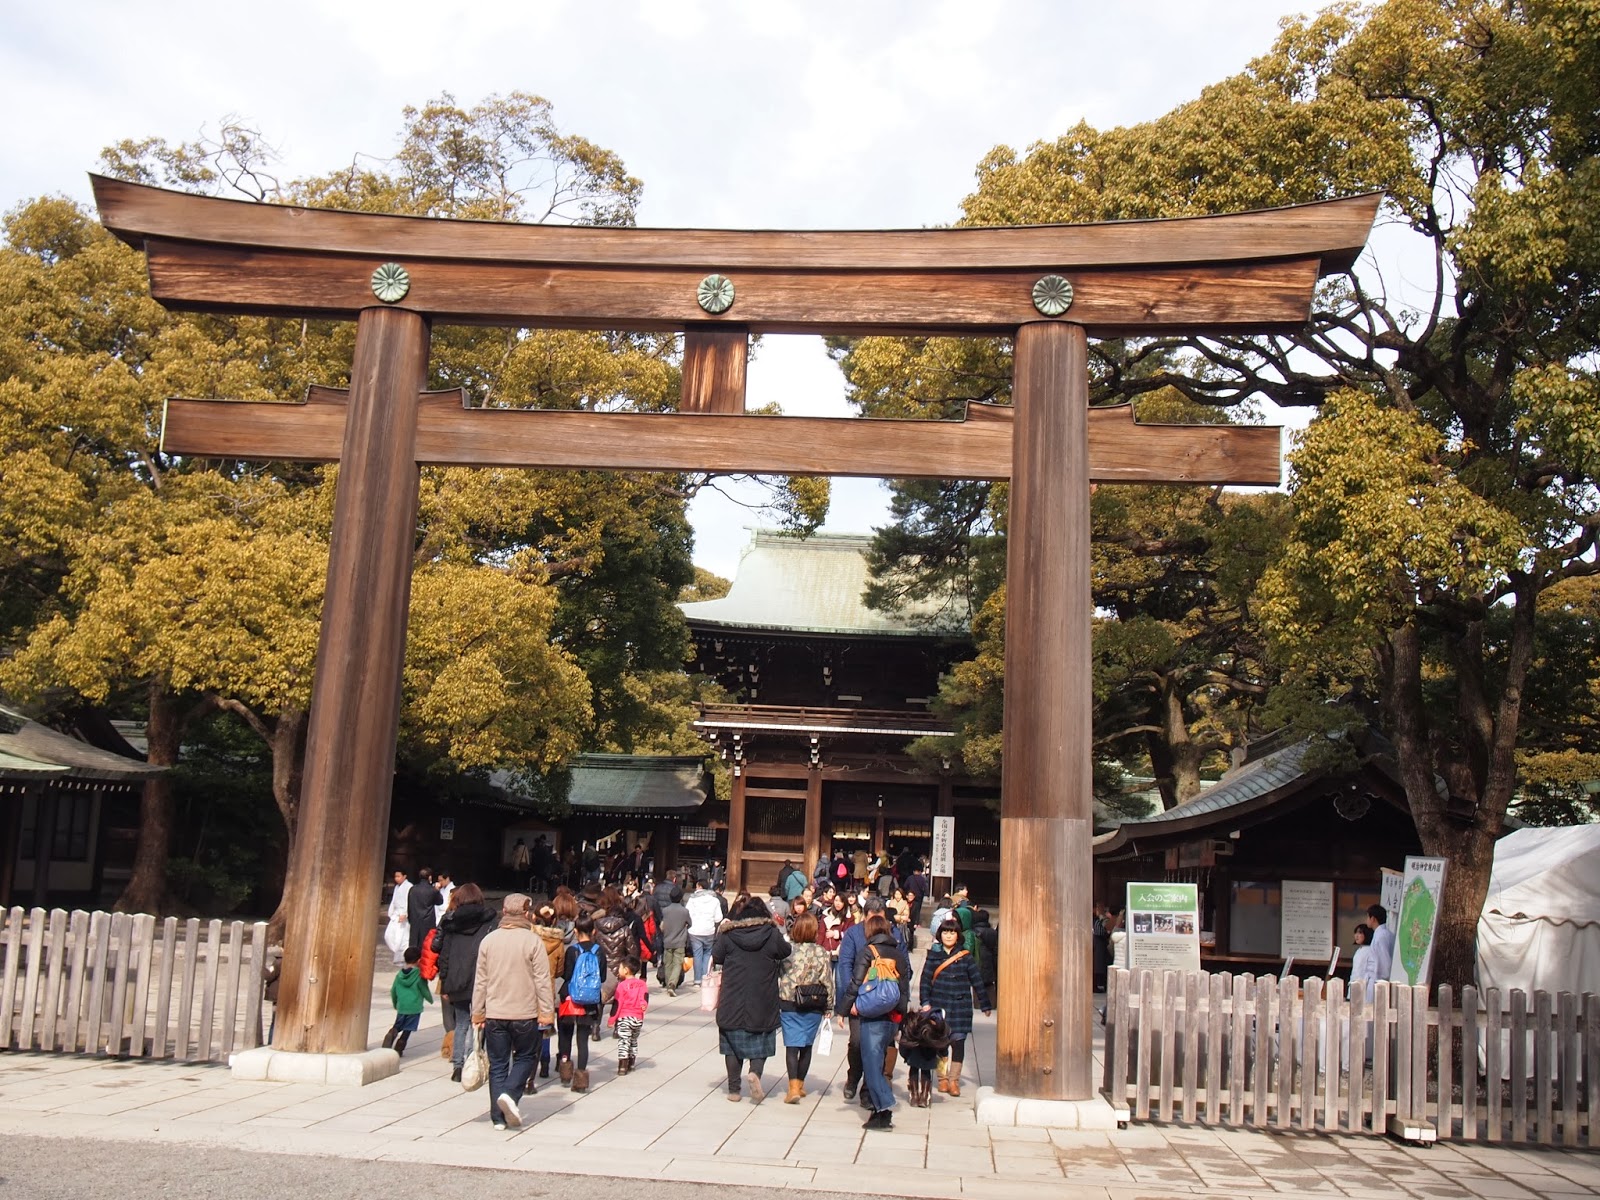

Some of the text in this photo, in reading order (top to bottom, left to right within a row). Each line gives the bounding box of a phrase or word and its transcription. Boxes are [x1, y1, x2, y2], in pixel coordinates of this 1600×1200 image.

[1138, 892, 1188, 903] 入会のご案内
